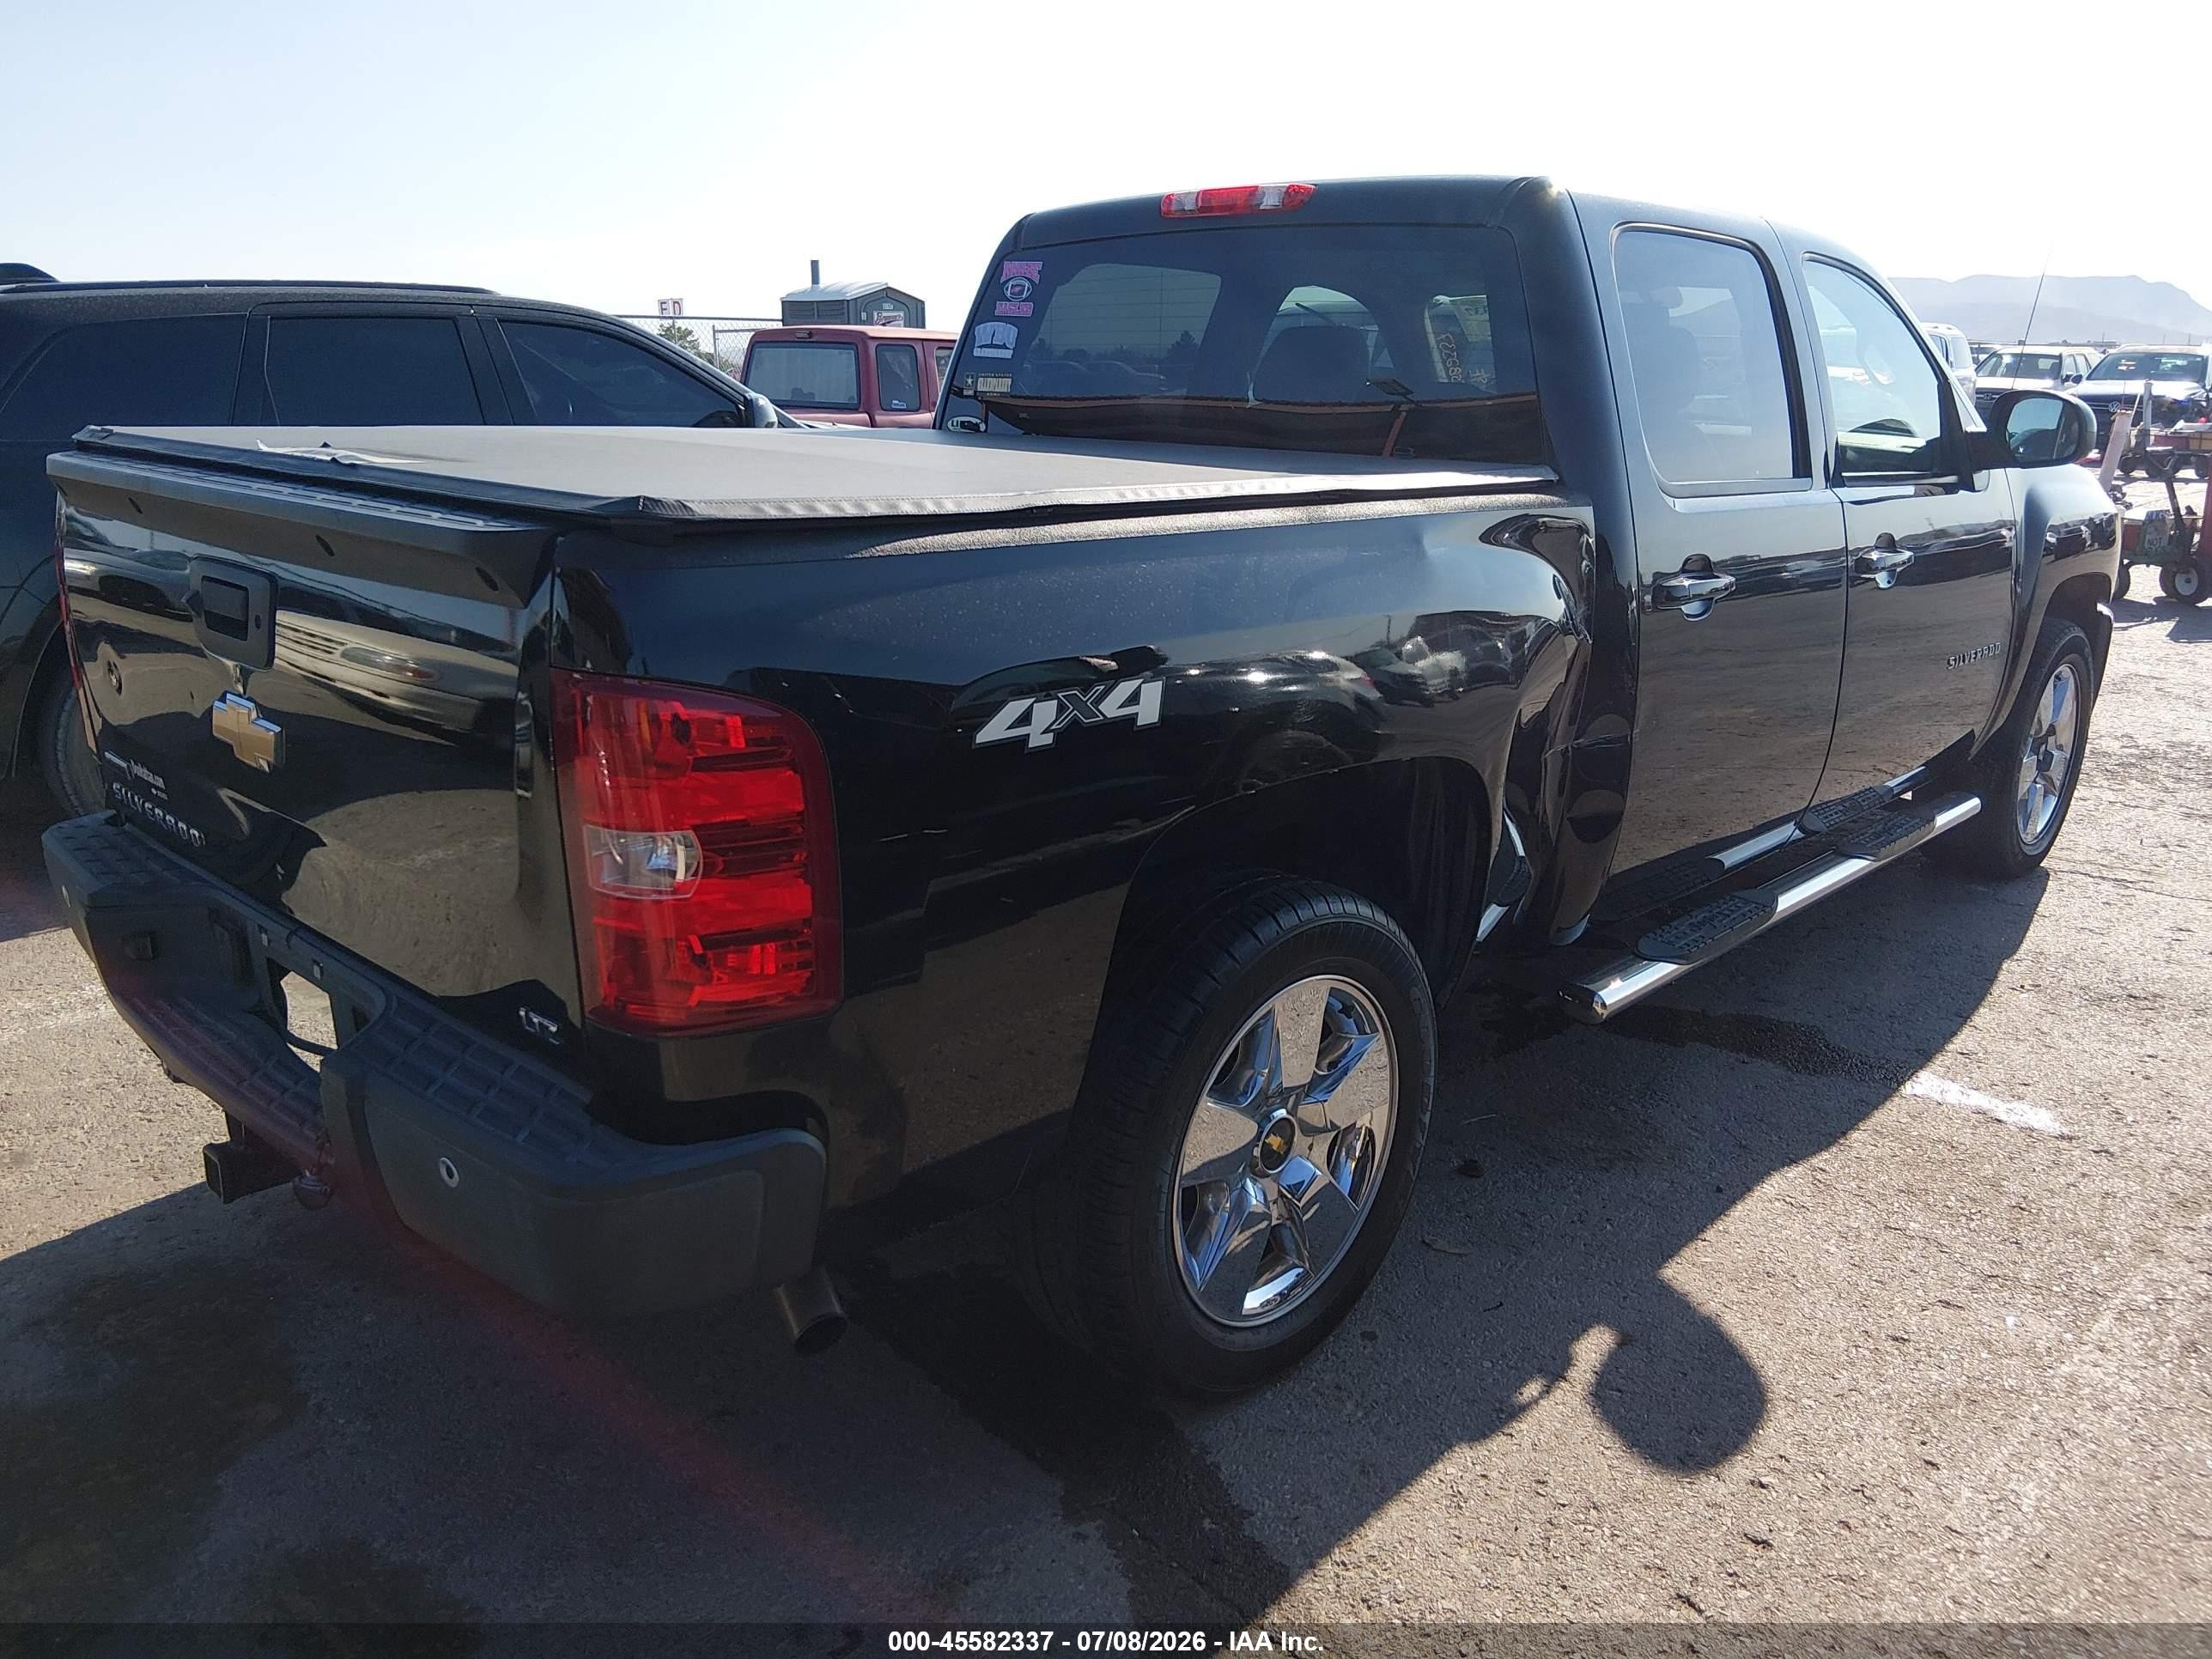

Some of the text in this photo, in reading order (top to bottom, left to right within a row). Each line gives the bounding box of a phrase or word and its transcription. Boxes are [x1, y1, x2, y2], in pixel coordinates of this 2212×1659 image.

[1947, 642, 2001, 670] SILVERADO
[112, 781, 201, 848] SILVERADO
[519, 1006, 561, 1045] LTZ
